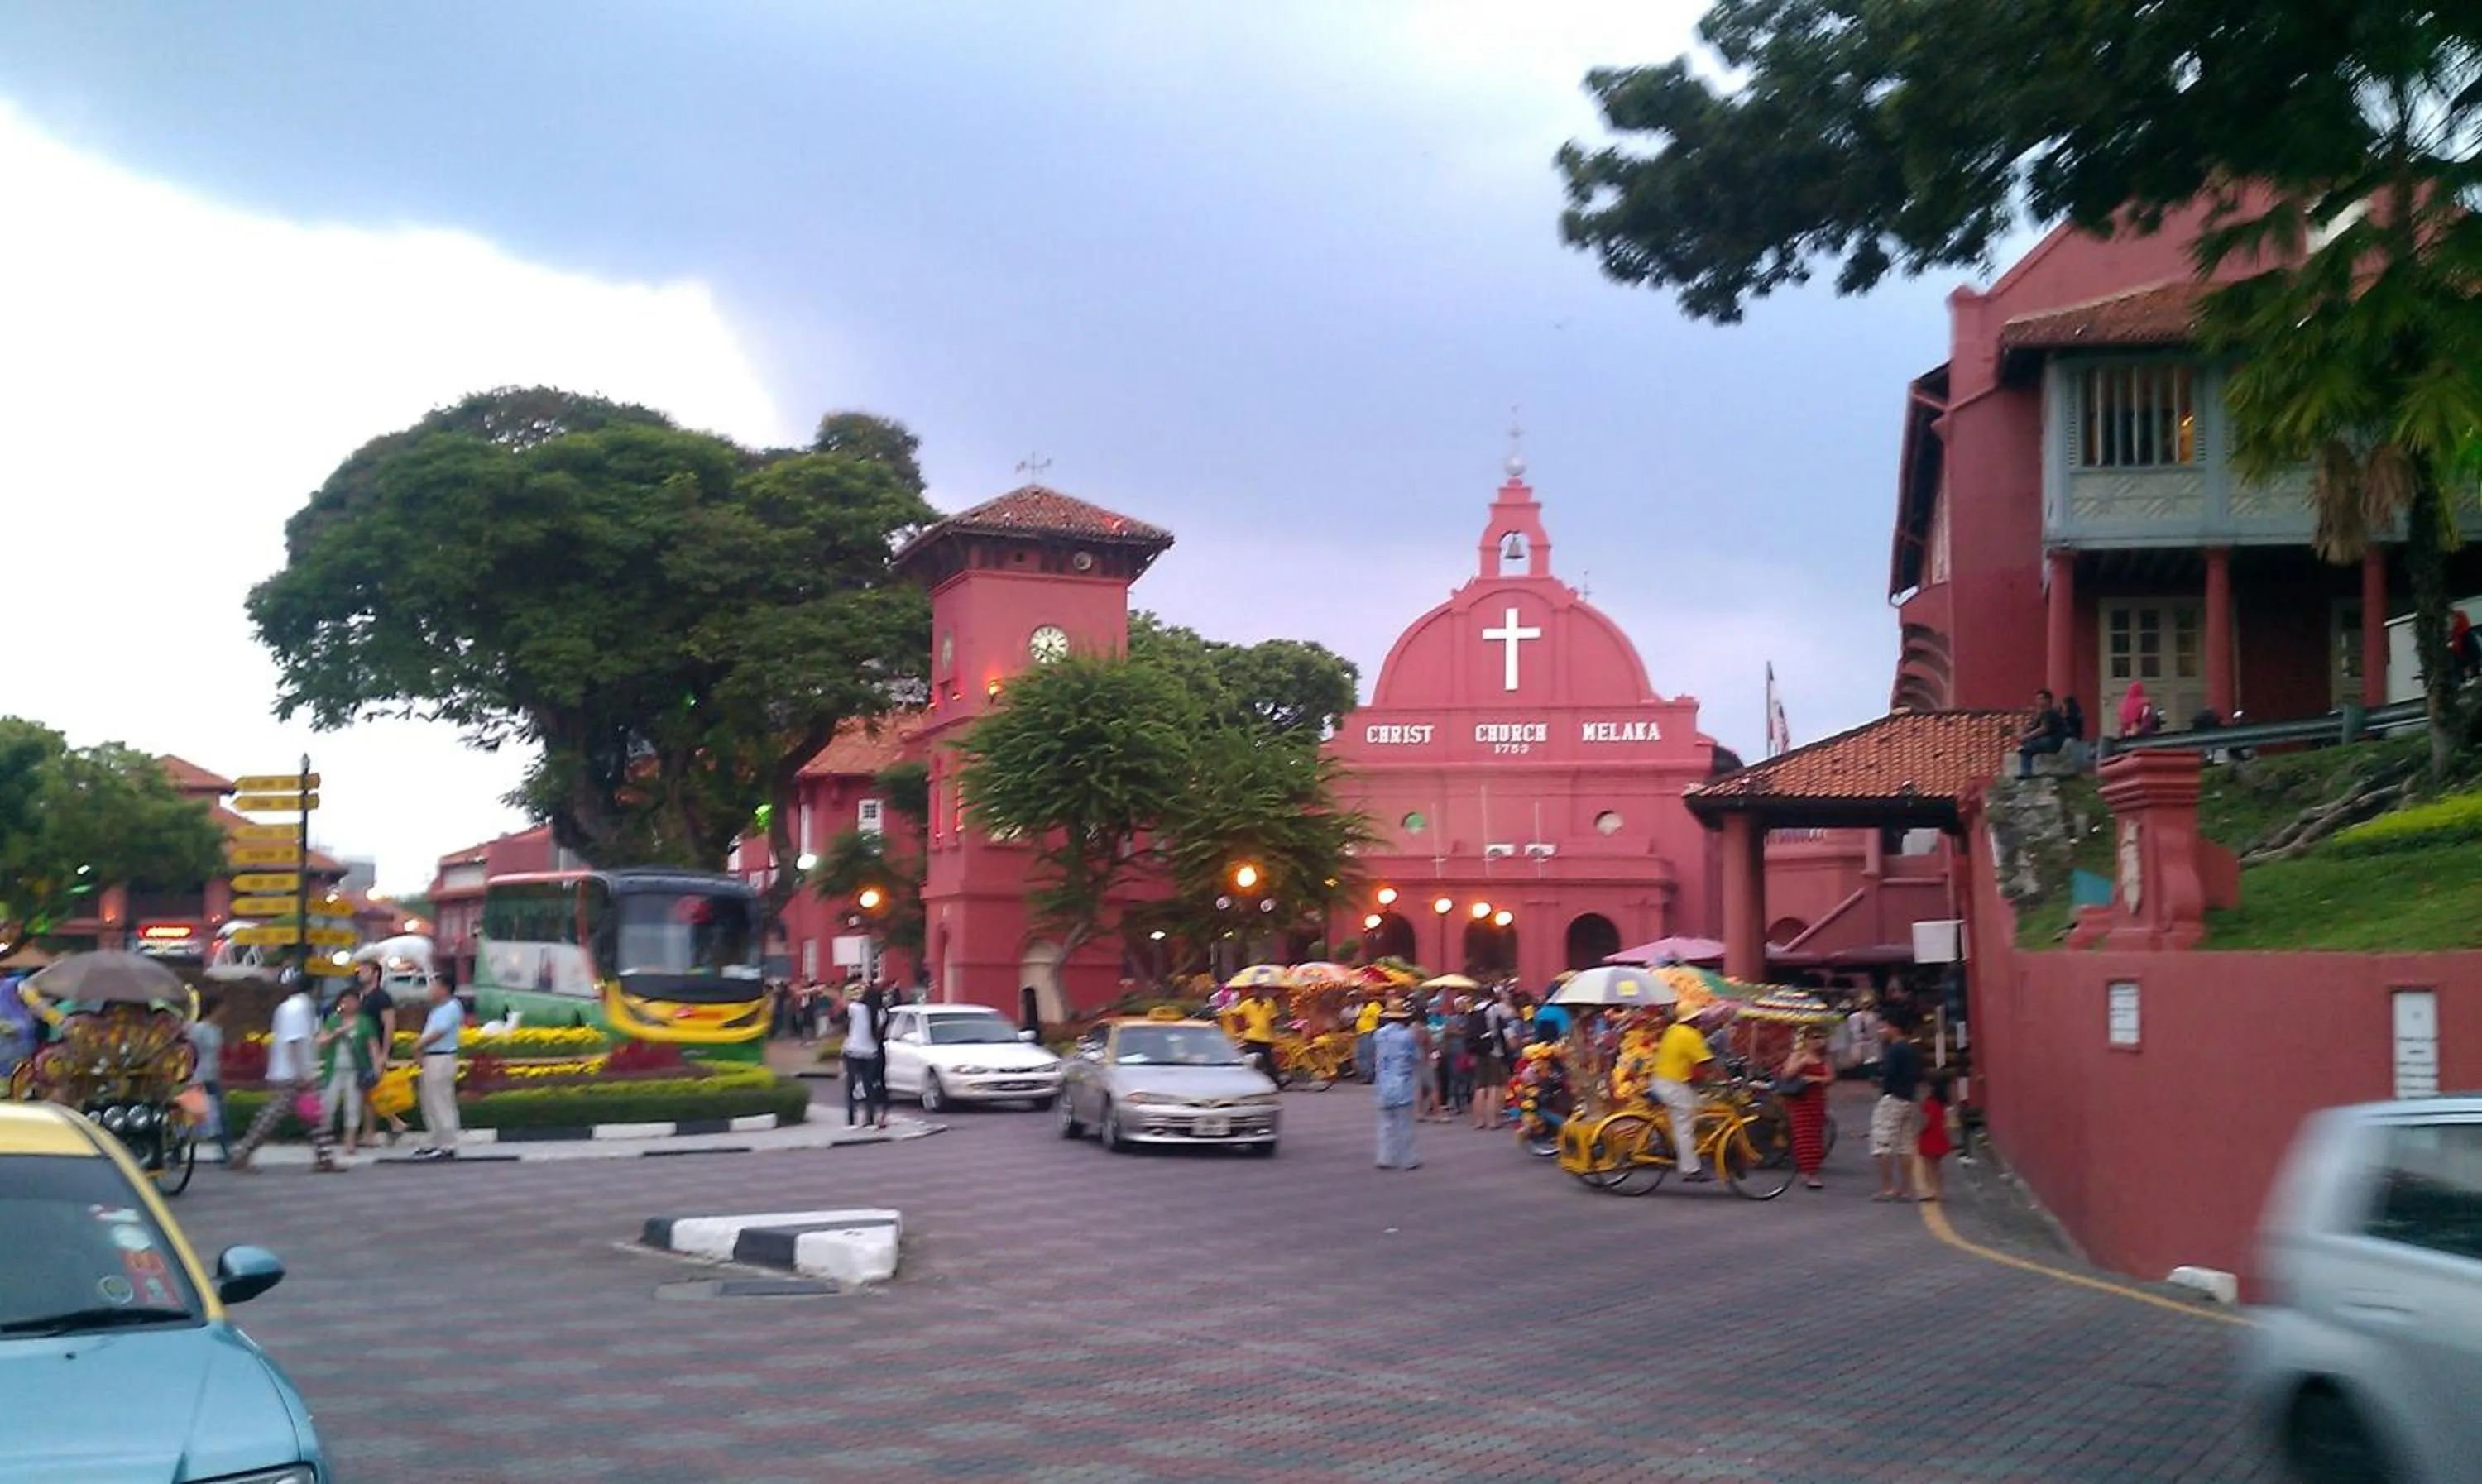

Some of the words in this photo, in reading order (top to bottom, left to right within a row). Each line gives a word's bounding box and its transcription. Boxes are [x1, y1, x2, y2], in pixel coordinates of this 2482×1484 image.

[1366, 725, 1435, 744] CHRIST
[1475, 723, 1548, 742] CHURCH
[1582, 722, 1661, 741] MELAKA
[1494, 744, 1530, 754] 1753
